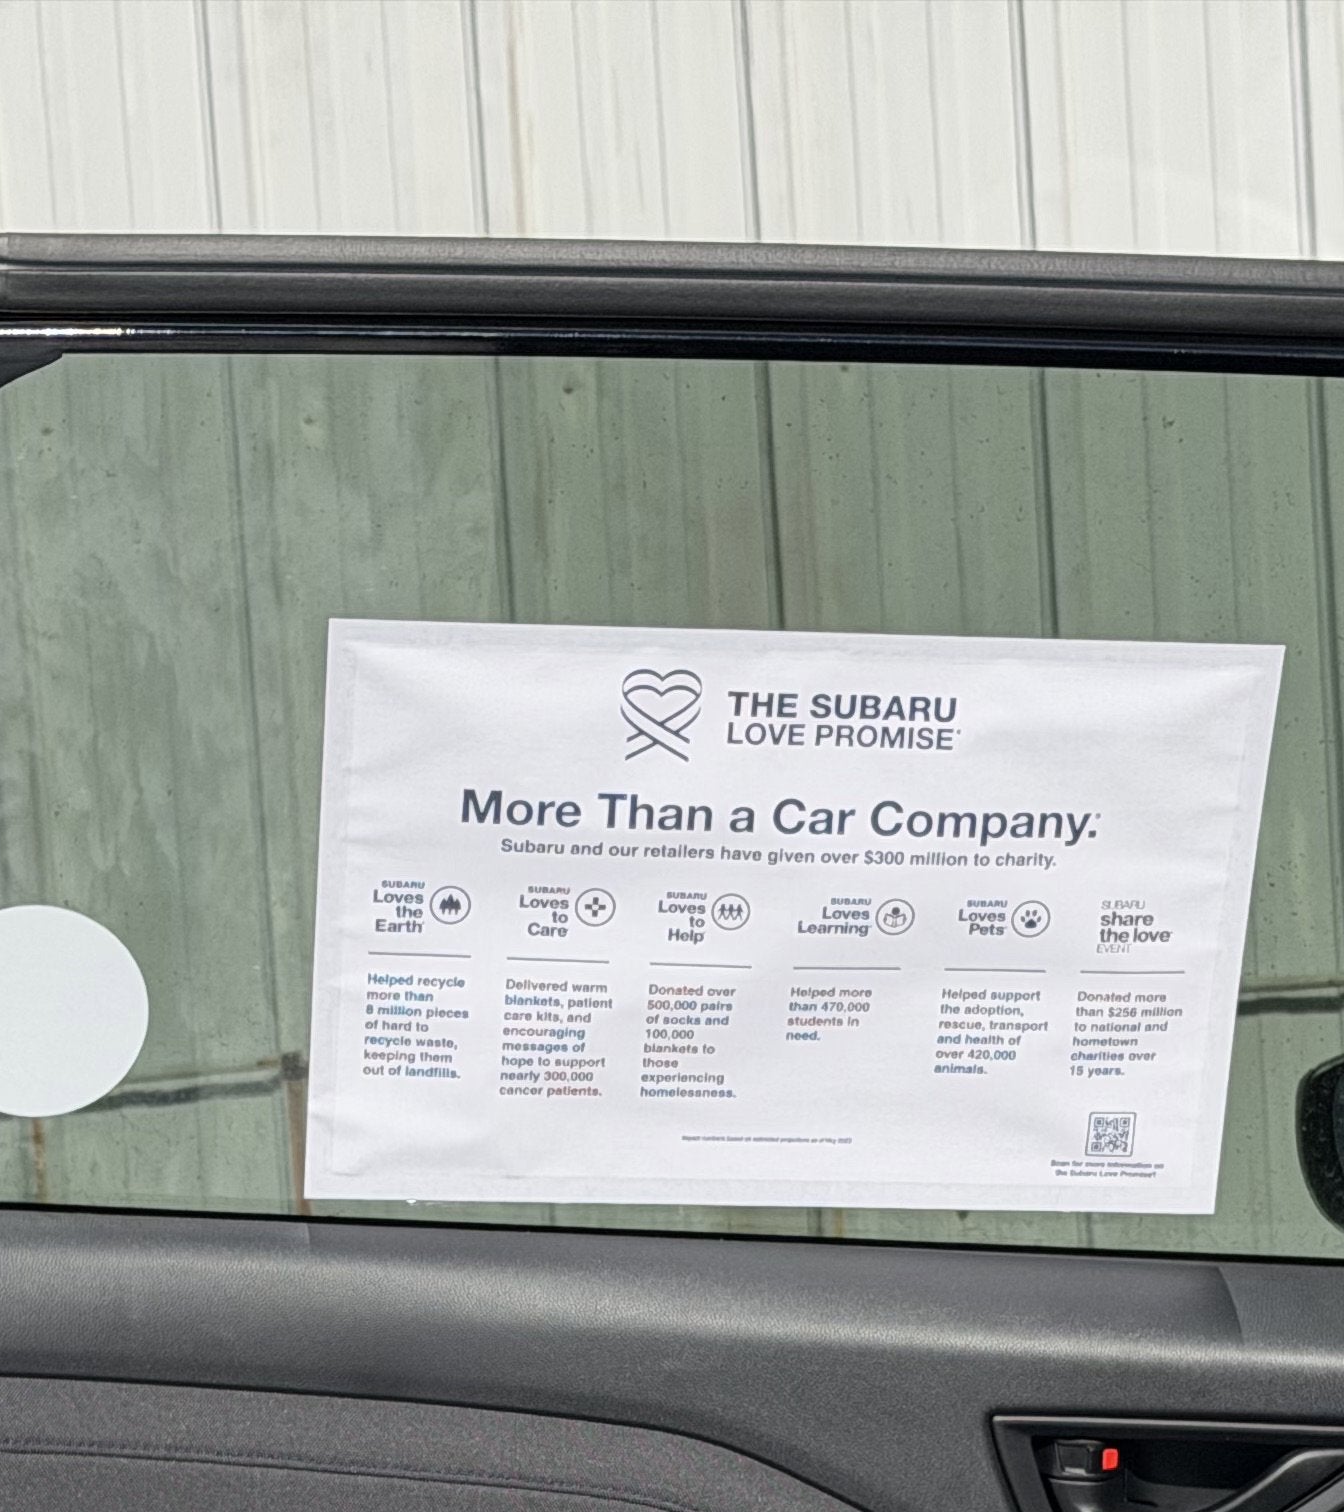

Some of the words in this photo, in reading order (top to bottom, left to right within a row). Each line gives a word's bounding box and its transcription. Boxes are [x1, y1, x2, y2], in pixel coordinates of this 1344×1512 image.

[728, 691, 798, 718] THE
[810, 694, 956, 722] SUBARU
[727, 722, 805, 745] LOVE
[815, 725, 954, 750] PROMISE
[462, 789, 581, 831] More
[598, 793, 712, 831] Than
[730, 807, 754, 832] a
[773, 799, 856, 835] Car
[501, 839, 565, 854] Subaru
[570, 842, 603, 859] and
[609, 846, 639, 860] our
[644, 845, 714, 859] retailers
[721, 846, 762, 861] have
[768, 849, 815, 865] given
[821, 853, 859, 864] over
[864, 850, 904, 865] $300
[910, 852, 968, 866] million
[974, 853, 990, 866] to
[996, 853, 1056, 870] charity.
[382, 880, 425, 889] SUBARU
[528, 886, 570, 895] SUBARU
[373, 887, 424, 904] Loves
[520, 893, 569, 909] Loves
[667, 892, 707, 900] SUBARU
[658, 898, 706, 914] Loves
[967, 900, 1008, 908] SUBARU
[1101, 900, 1145, 910] SUBARU
[396, 906, 423, 918] the
[552, 911, 568, 923] to
[822, 904, 870, 920] Loves
[959, 907, 1006, 924] Loves
[689, 913, 705, 930] to
[1101, 911, 1154, 926] share
[375, 917, 424, 933] Earth
[528, 921, 568, 937] Care
[798, 919, 871, 937] Learning
[969, 921, 1006, 935] Pets
[668, 926, 704, 944] Help
[1100, 928, 1129, 943] the
[1133, 928, 1172, 942] love
[1096, 942, 1131, 953] EVENT
[368, 973, 413, 987] Helped
[418, 977, 465, 989] recycle
[506, 979, 568, 992] Delivered
[572, 984, 607, 992] warm
[367, 991, 400, 1000] more
[405, 991, 433, 1001] than
[649, 984, 703, 996] Donated
[707, 988, 736, 996] over
[791, 987, 835, 999] Helped
[839, 989, 872, 997] more
[942, 989, 987, 1001] Helped
[991, 991, 1040, 1002] support
[505, 994, 564, 1008] blankets,
[568, 998, 612, 1010] patient
[1078, 991, 1131, 1002] Donated
[1135, 994, 1166, 1002] more
[366, 1004, 373, 1014] 8
[377, 1006, 422, 1016] million
[426, 1008, 469, 1019] pieces
[648, 1000, 697, 1011] 500,000
[701, 1001, 732, 1012] pairs
[789, 1002, 817, 1011] than
[821, 1002, 870, 1012] 470,000
[941, 1004, 960, 1014] the
[964, 1004, 1024, 1017] adoption,
[1076, 1007, 1103, 1017] than
[1141, 1007, 1182, 1017] million
[504, 1012, 532, 1021] care
[537, 1011, 563, 1023] kits,
[567, 1013, 591, 1023] and
[646, 1014, 659, 1024] of
[663, 1016, 701, 1025] socks
[705, 1016, 729, 1025] and
[788, 1016, 843, 1026] students
[848, 1016, 859, 1026] in
[365, 1020, 378, 1029] of
[382, 1021, 412, 1031] hard
[416, 1022, 429, 1032] to
[939, 1021, 985, 1031] rescue,
[989, 1021, 1048, 1034] transport
[1075, 1022, 1087, 1032] to
[1091, 1022, 1141, 1032] national
[1145, 1021, 1168, 1031] and
[503, 1027, 585, 1040] encouraging
[646, 1029, 694, 1040] 100,000
[786, 1031, 820, 1040] need.
[937, 1034, 961, 1044] and
[965, 1034, 1004, 1044] health
[1008, 1035, 1021, 1045] of
[364, 1036, 411, 1049] recycle
[416, 1038, 457, 1049] waste,
[1073, 1037, 1138, 1046] hometown
[502, 1043, 568, 1054] messages
[572, 1042, 585, 1052] of
[644, 1043, 698, 1054] blankets
[703, 1044, 715, 1054] to
[364, 1049, 415, 1064] keeping
[420, 1052, 452, 1063] them
[936, 1050, 964, 1059] over
[968, 1049, 1016, 1060] 420,000
[1071, 1051, 1124, 1061] charities
[1128, 1052, 1156, 1061] over
[502, 1056, 534, 1068] hope
[538, 1057, 550, 1066] to
[555, 1058, 605, 1069] support
[643, 1058, 678, 1068] those
[363, 1065, 384, 1075] out
[388, 1065, 401, 1075] of
[405, 1066, 460, 1078] landfills.
[934, 1064, 987, 1074] animals.
[1070, 1065, 1083, 1076] 15
[1088, 1068, 1124, 1078] years.
[500, 1071, 540, 1083] nearly
[544, 1071, 593, 1082] 300,000
[641, 1072, 724, 1085] experiencing
[499, 1087, 543, 1095] cancer
[547, 1086, 602, 1097] patients.
[640, 1084, 736, 1098] homelessness.
